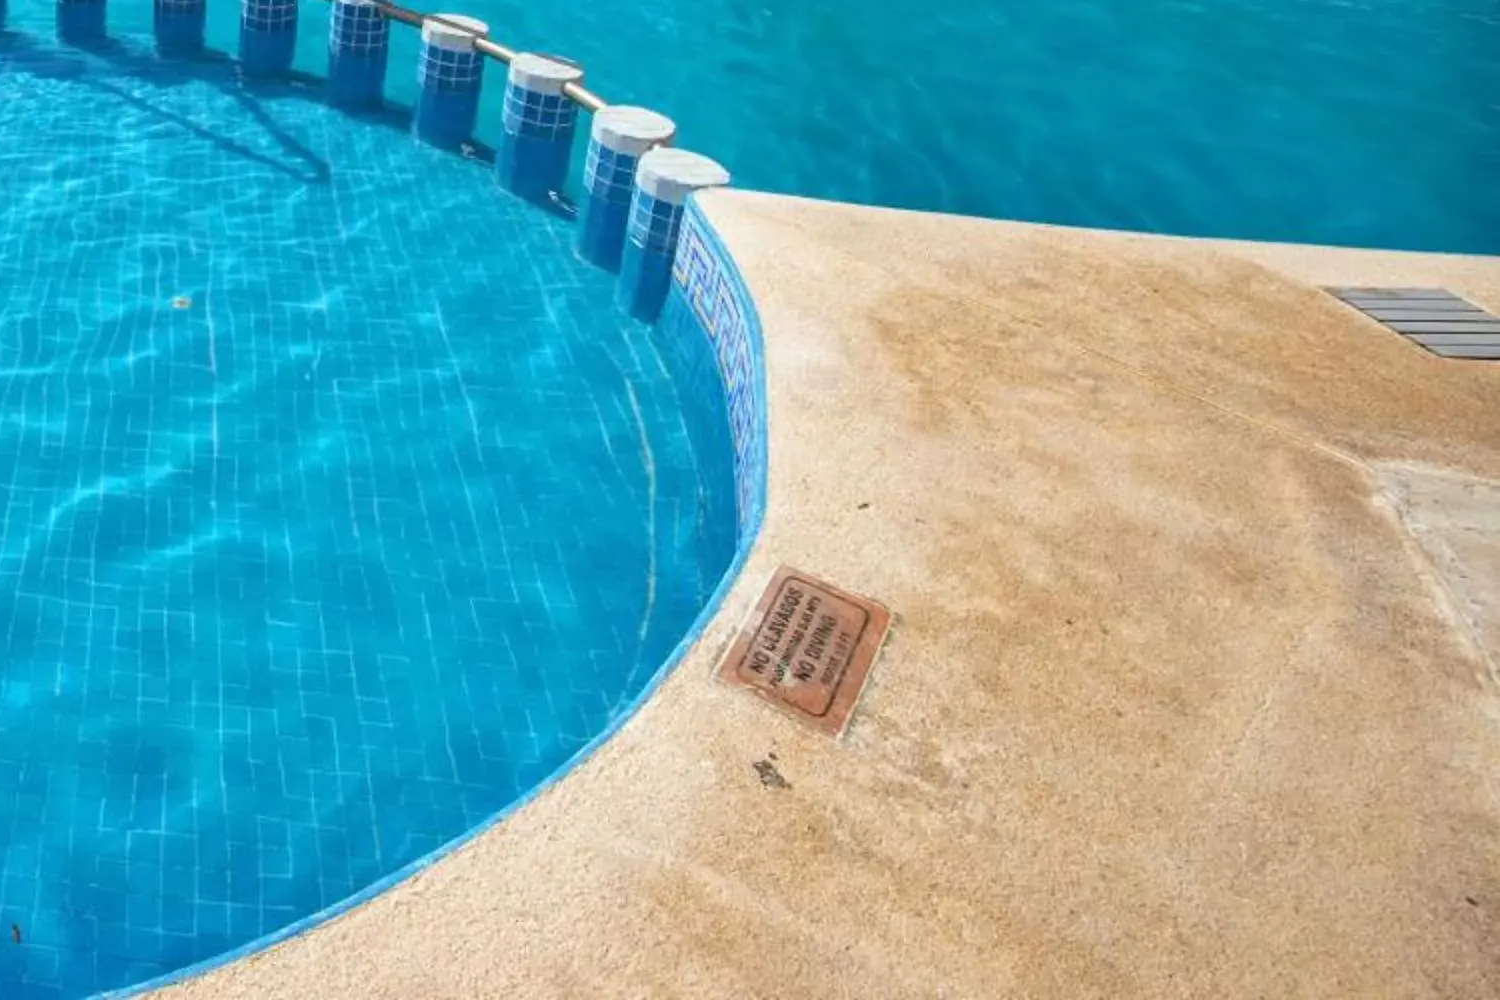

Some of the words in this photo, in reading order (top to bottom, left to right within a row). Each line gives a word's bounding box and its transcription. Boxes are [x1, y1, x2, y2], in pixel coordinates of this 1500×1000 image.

[749, 650, 770, 673] NO
[794, 659, 815, 682] NO
[808, 615, 837, 660] DIVING
